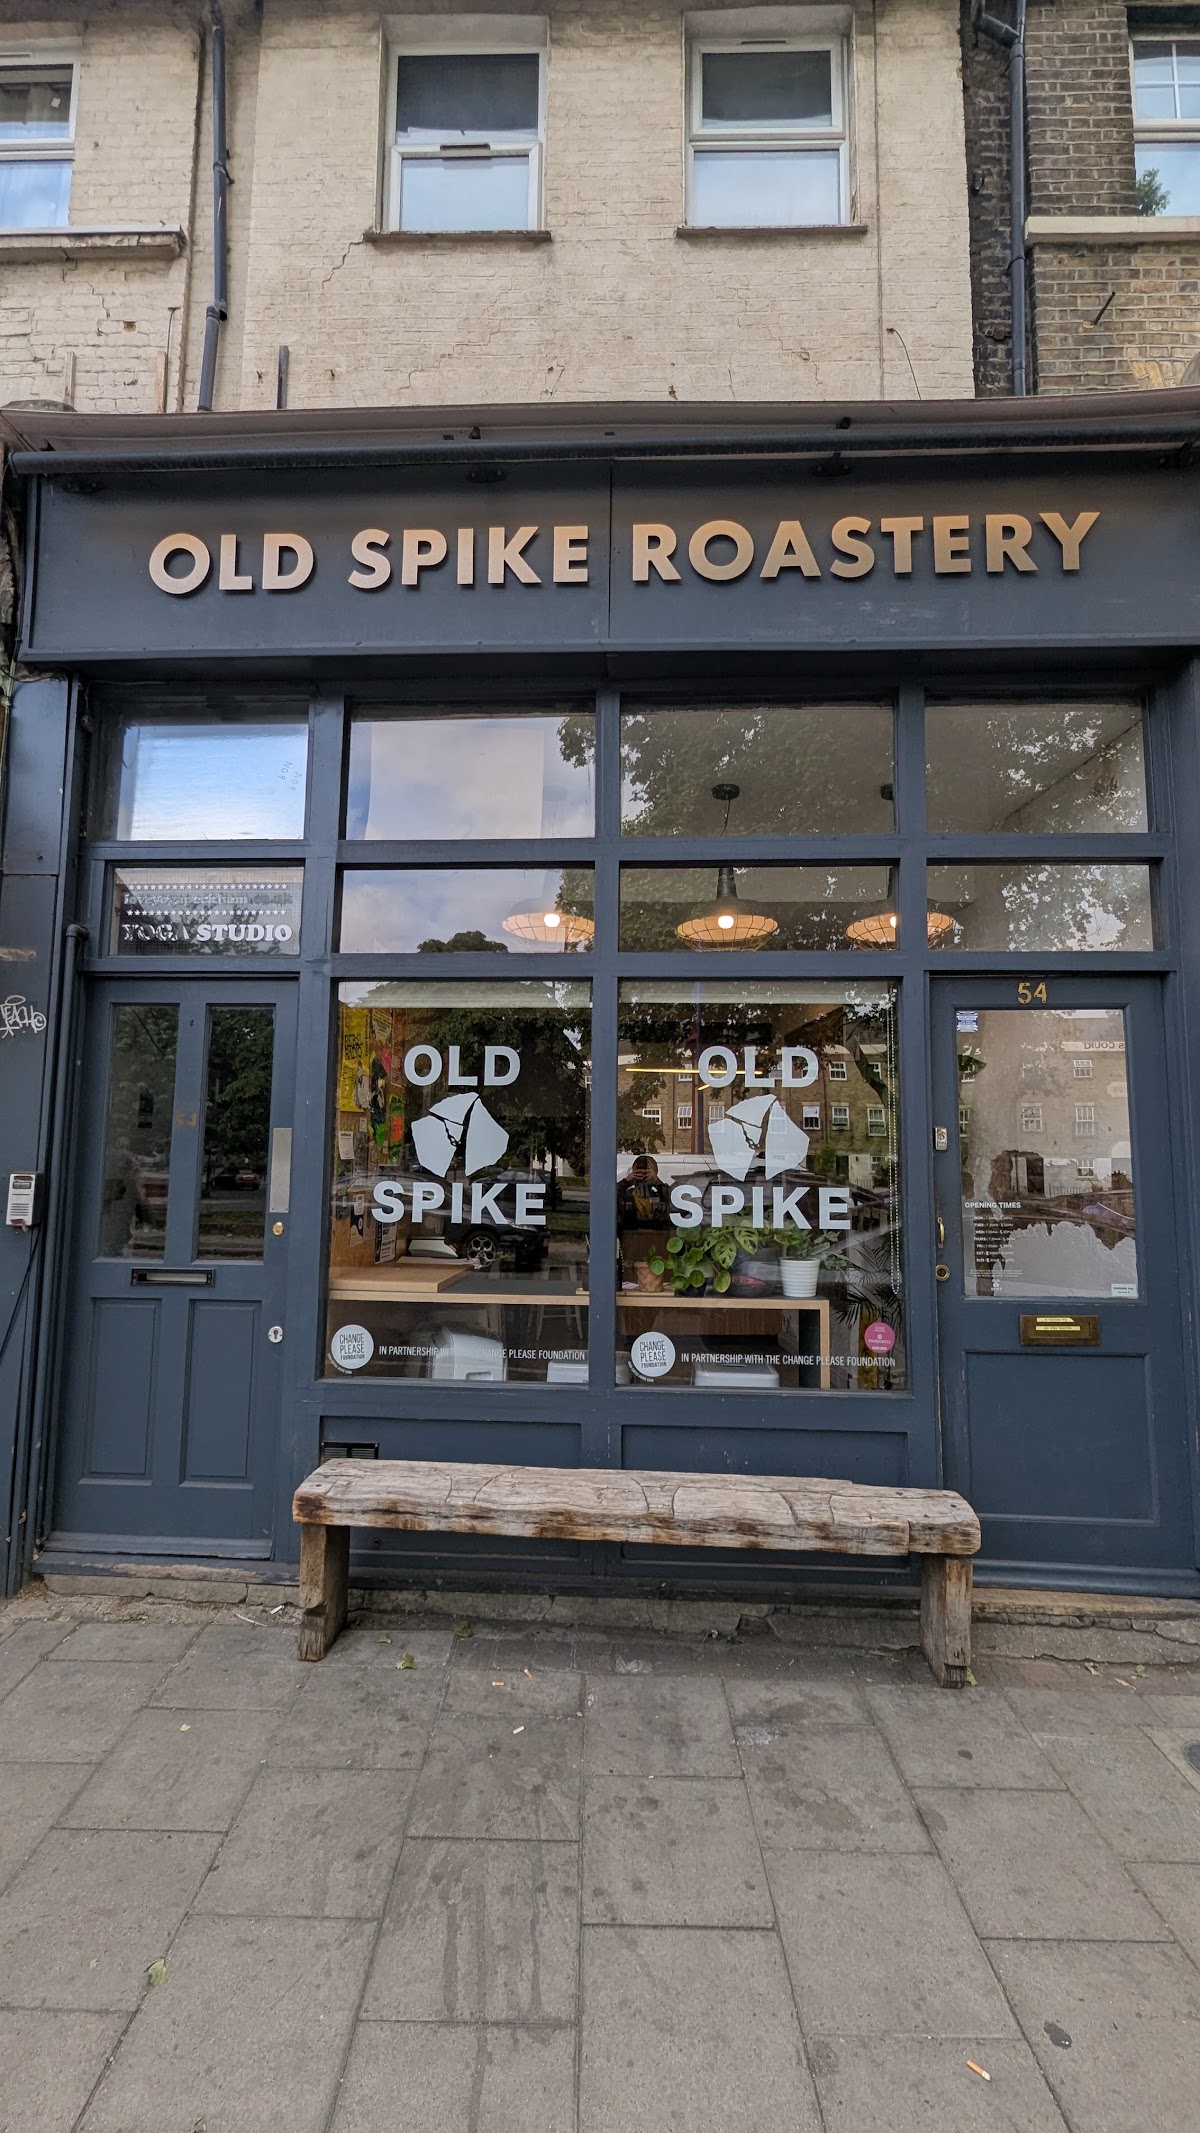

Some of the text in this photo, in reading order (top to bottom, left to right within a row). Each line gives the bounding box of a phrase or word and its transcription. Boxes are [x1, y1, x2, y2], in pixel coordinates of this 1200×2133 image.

[149, 512, 1100, 595] OLD SPIKE ROASTERY
[196, 924, 293, 942] STUDIO
[1017, 982, 1047, 1004] 54
[404, 1045, 520, 1087] OLD
[699, 1046, 819, 1088] OLD
[372, 1181, 547, 1225] SPIKE
[669, 1185, 851, 1230] SPIKE
[340, 1333, 364, 1344] CHANGE
[640, 1340, 665, 1352] CHANGE
[340, 1343, 365, 1354] PLEASE
[379, 1346, 387, 1355] IN
[389, 1346, 439, 1357] PARTNERSHIP
[440, 1347, 456, 1357] WIT
[508, 1349, 536, 1359] PLEASE
[538, 1350, 585, 1360] FOUNDATION
[640, 1351, 666, 1363] PLEASE
[681, 1353, 896, 1367] IN PARTNERSHIP WITH THE CHANGE PLEASE FOUNDATION
